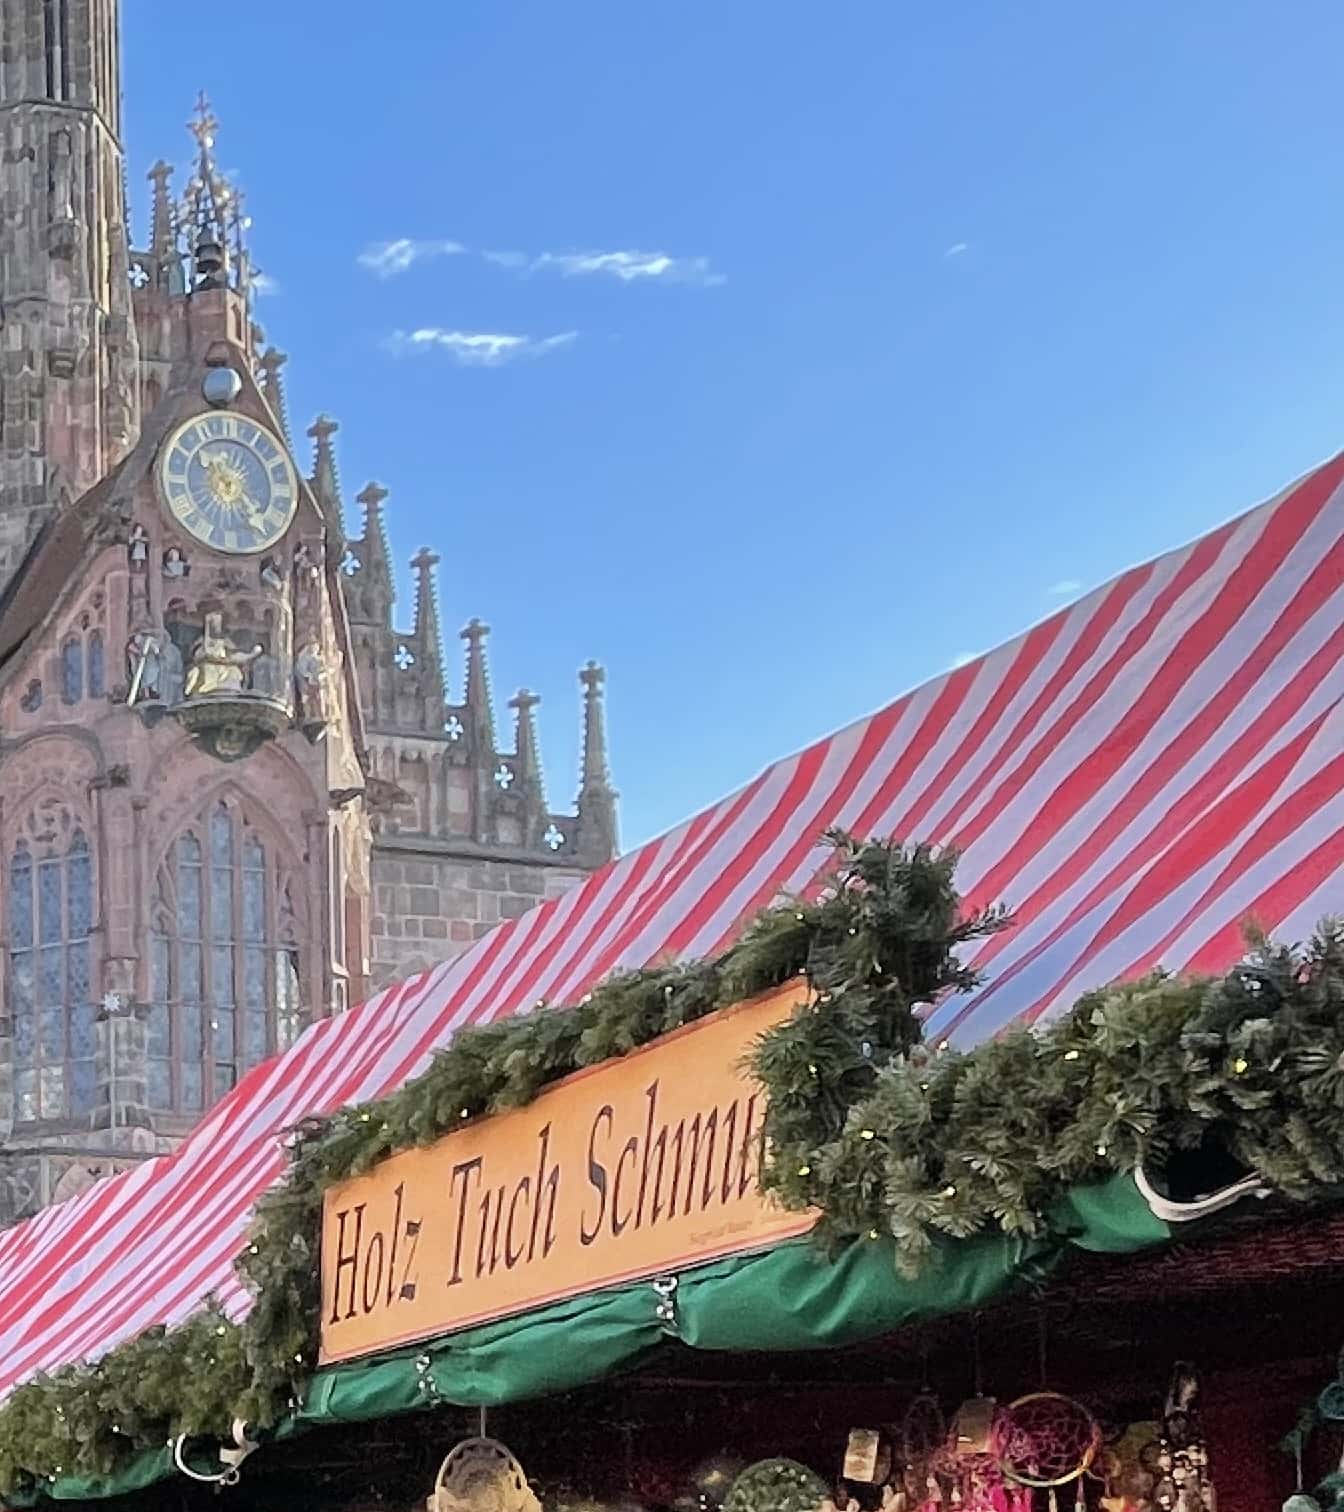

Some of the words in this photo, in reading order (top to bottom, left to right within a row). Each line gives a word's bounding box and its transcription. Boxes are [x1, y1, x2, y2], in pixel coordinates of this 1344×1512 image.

[329, 1181, 424, 1325] Holz
[447, 1120, 560, 1286] Tuch
[580, 1078, 755, 1246] Schmu
